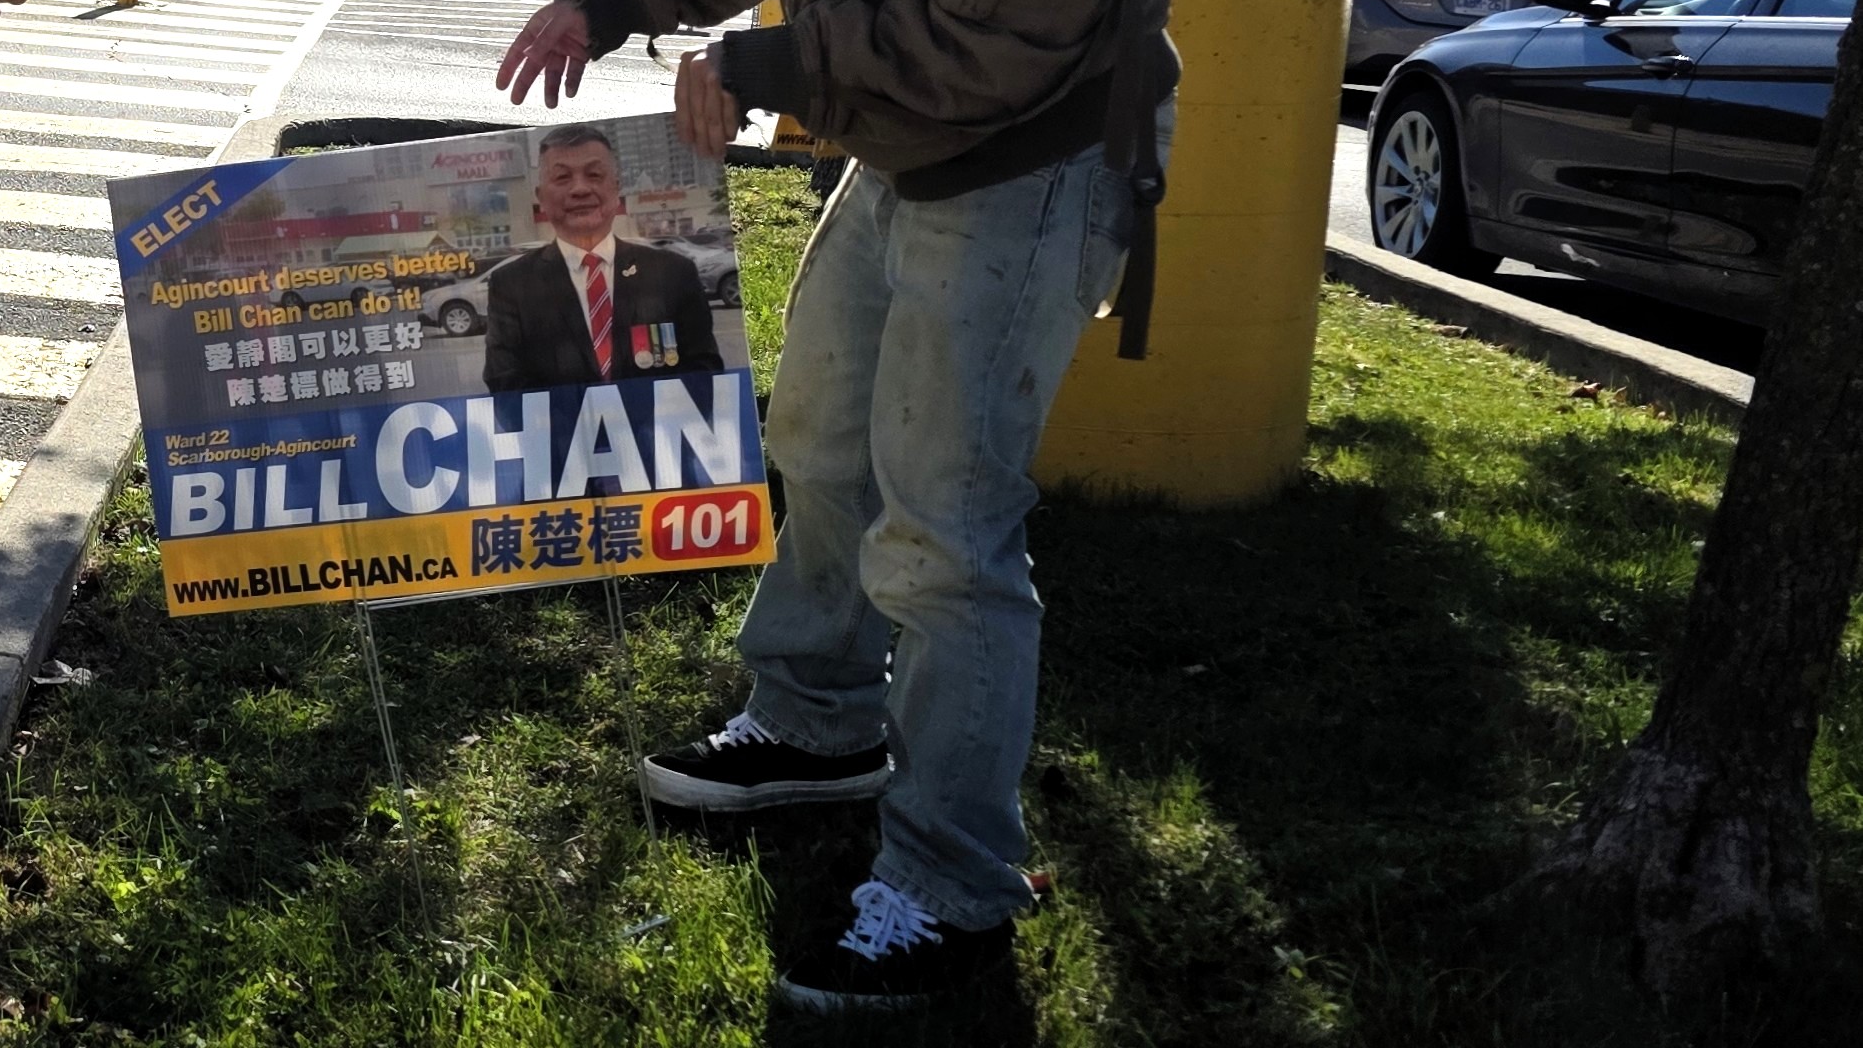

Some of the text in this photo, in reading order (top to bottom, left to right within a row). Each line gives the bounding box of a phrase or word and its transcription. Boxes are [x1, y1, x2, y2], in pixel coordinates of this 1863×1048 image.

[130, 180, 223, 258] ELECT
[151, 251, 476, 308] Agincourt deserves better,
[194, 286, 424, 334] Bill Chan can do it!
[204, 321, 424, 372] 愛靜閣可以更好
[226, 360, 416, 407] 陳楚標做得到
[165, 430, 230, 450] Ward 22
[167, 434, 357, 467] Scarborough-Agincourt
[170, 373, 742, 537] BILL CHAN
[470, 504, 643, 577] 陳楚標
[661, 500, 749, 551] 101
